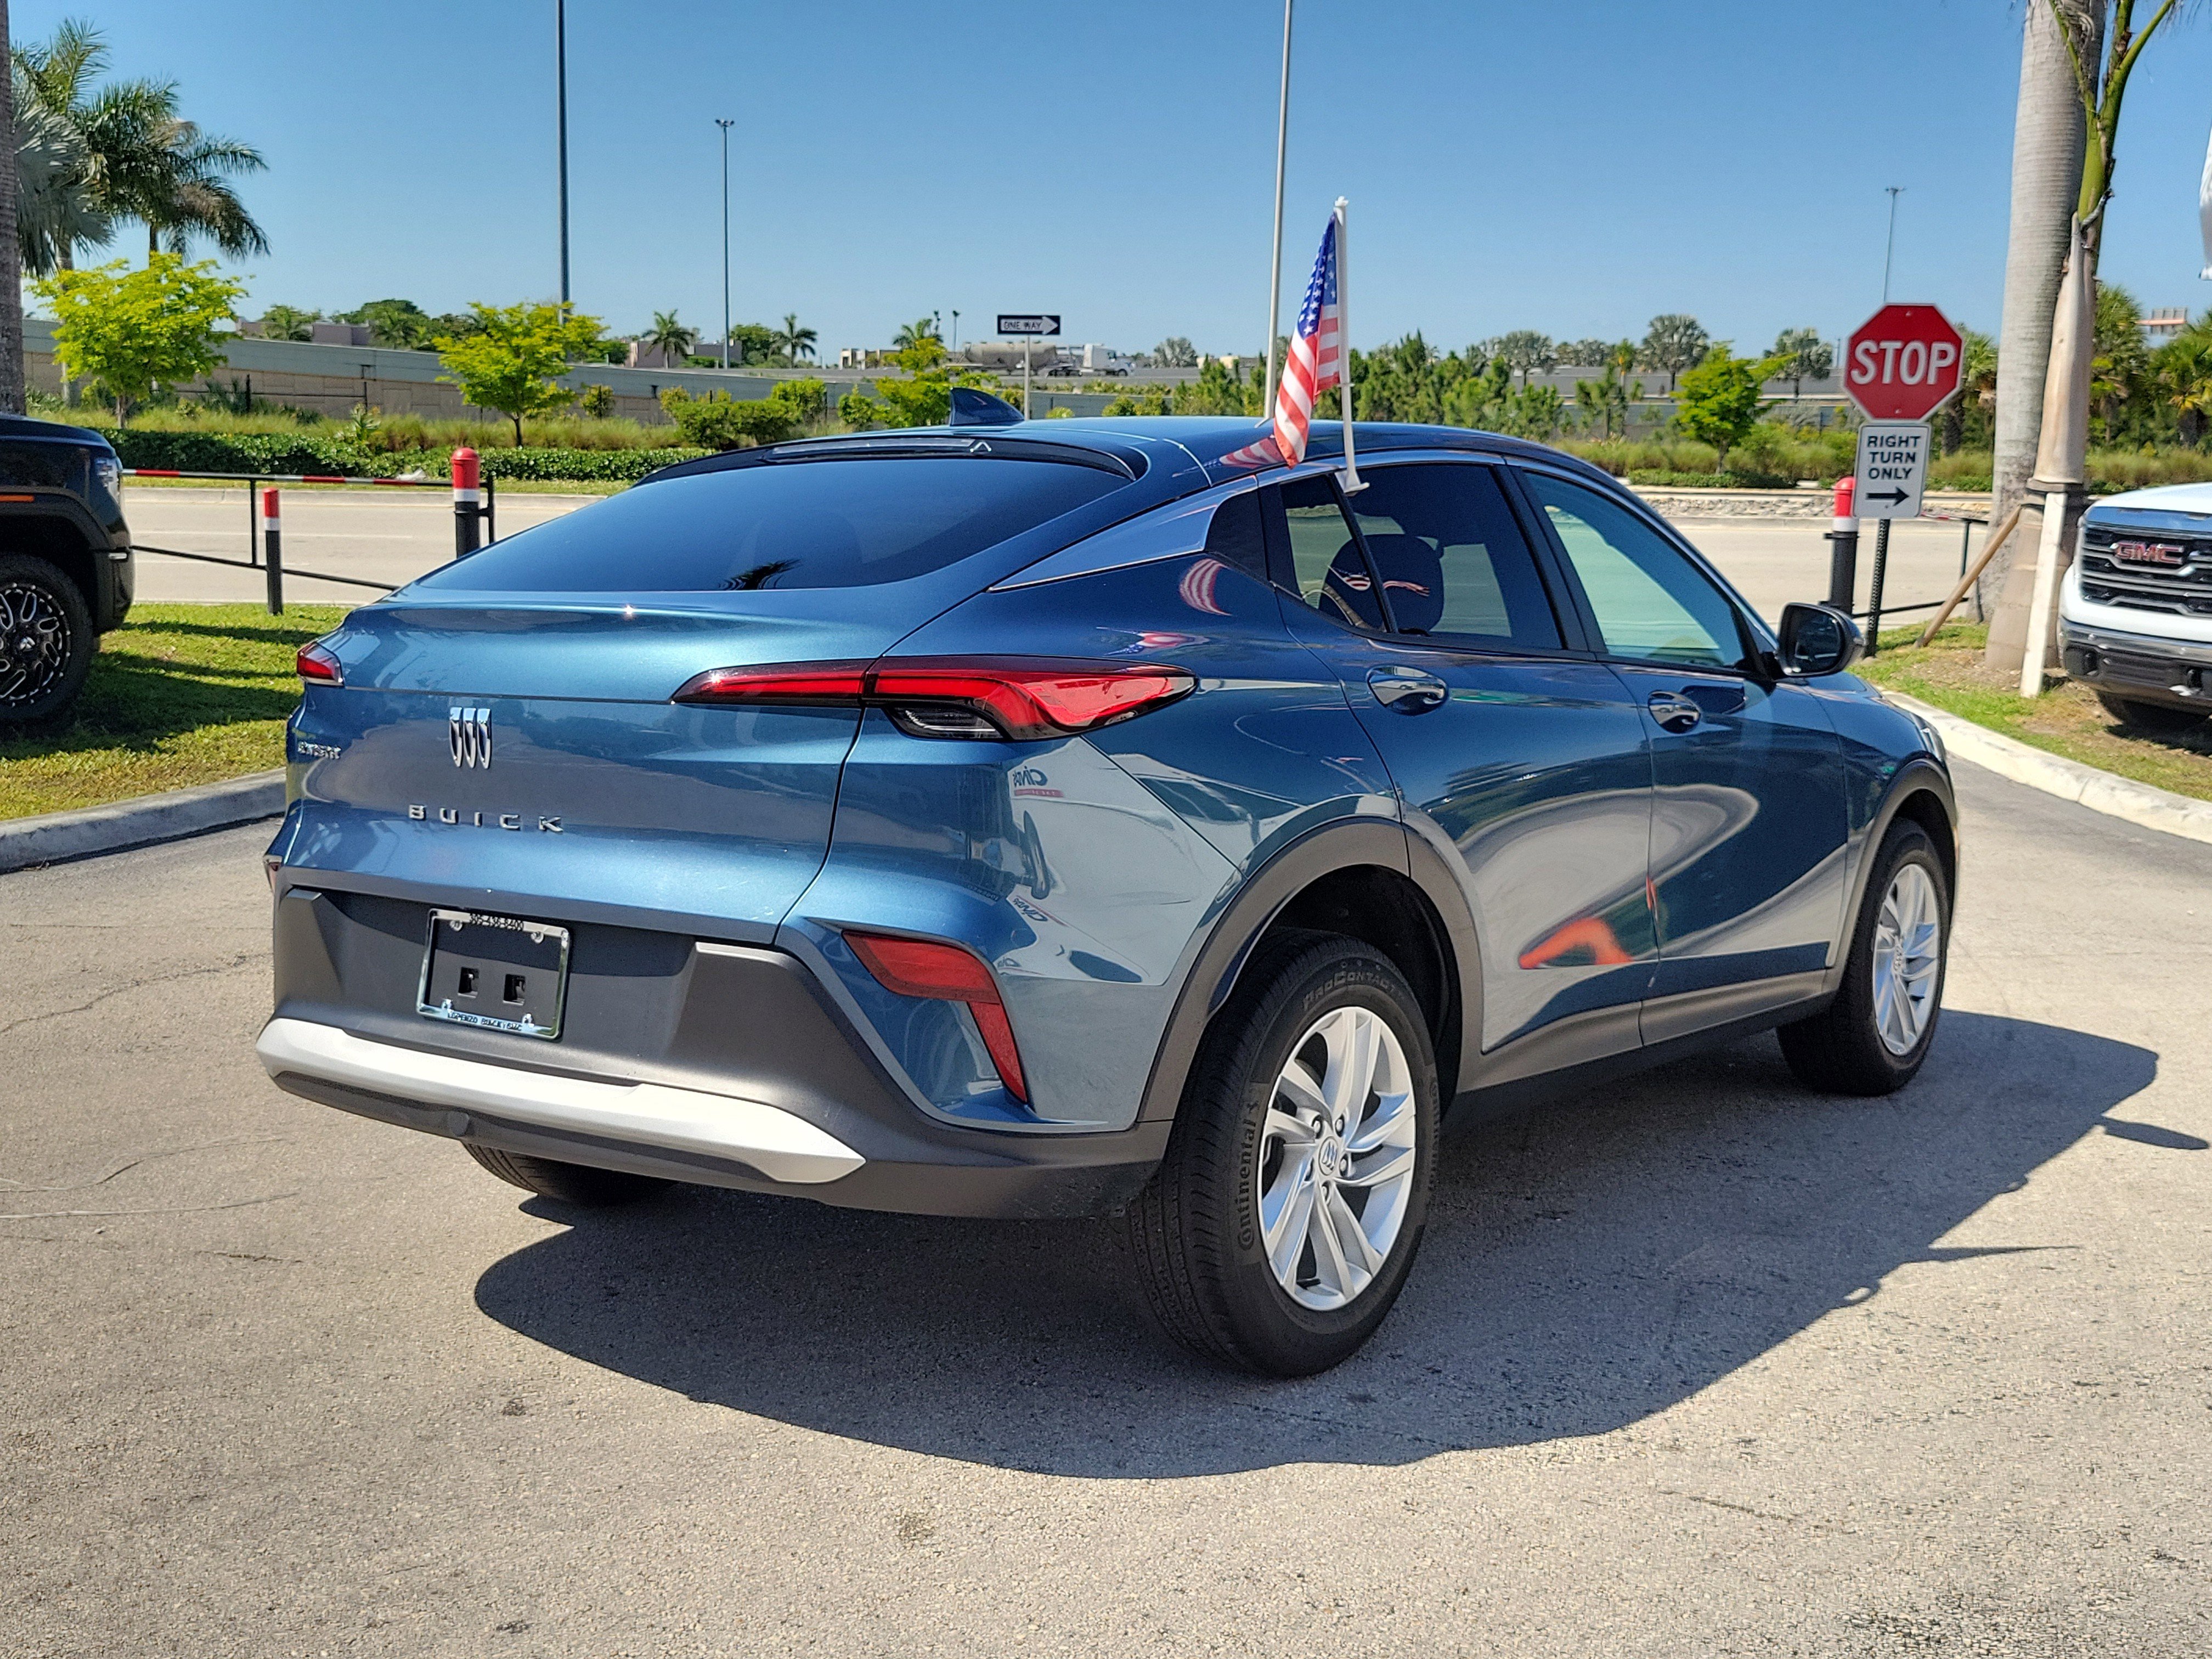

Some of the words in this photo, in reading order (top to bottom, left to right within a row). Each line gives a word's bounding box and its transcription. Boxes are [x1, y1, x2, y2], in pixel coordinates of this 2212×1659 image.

[1004, 321, 1019, 330] ONE
[1024, 321, 1042, 330] WAY
[1850, 340, 1957, 385] STOP
[1867, 436, 1921, 448] RIGHT
[1869, 452, 1916, 464] TURN
[1869, 467, 1912, 480] ONLY
[2113, 541, 2184, 565] GMC
[409, 804, 563, 832] BUICK
[1238, 1118, 1256, 1251] Continental
